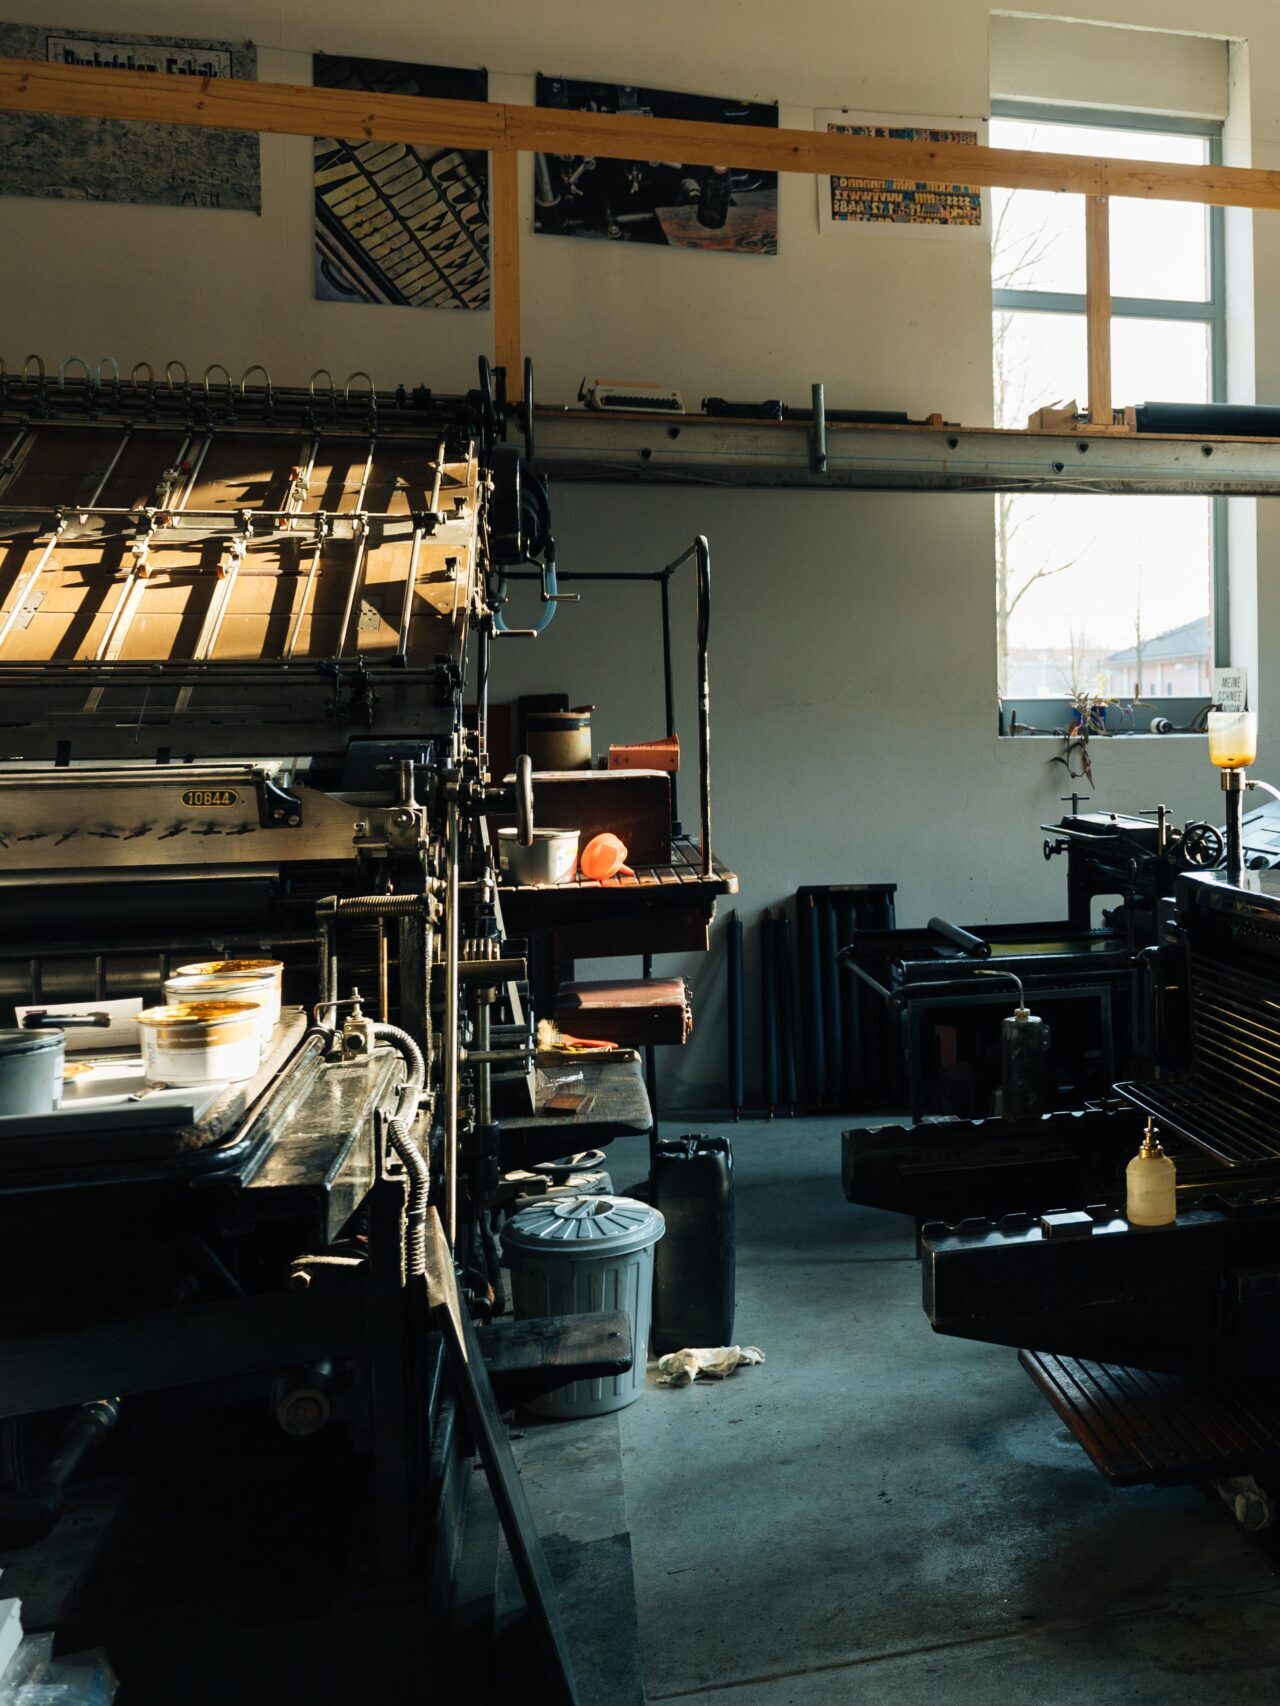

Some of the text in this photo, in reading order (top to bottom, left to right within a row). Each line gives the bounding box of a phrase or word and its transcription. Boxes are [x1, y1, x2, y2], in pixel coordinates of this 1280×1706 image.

[1222, 677, 1242, 688] MEINE
[1217, 690, 1242, 702] SCHNEE
[187, 792, 230, 805] 10844
